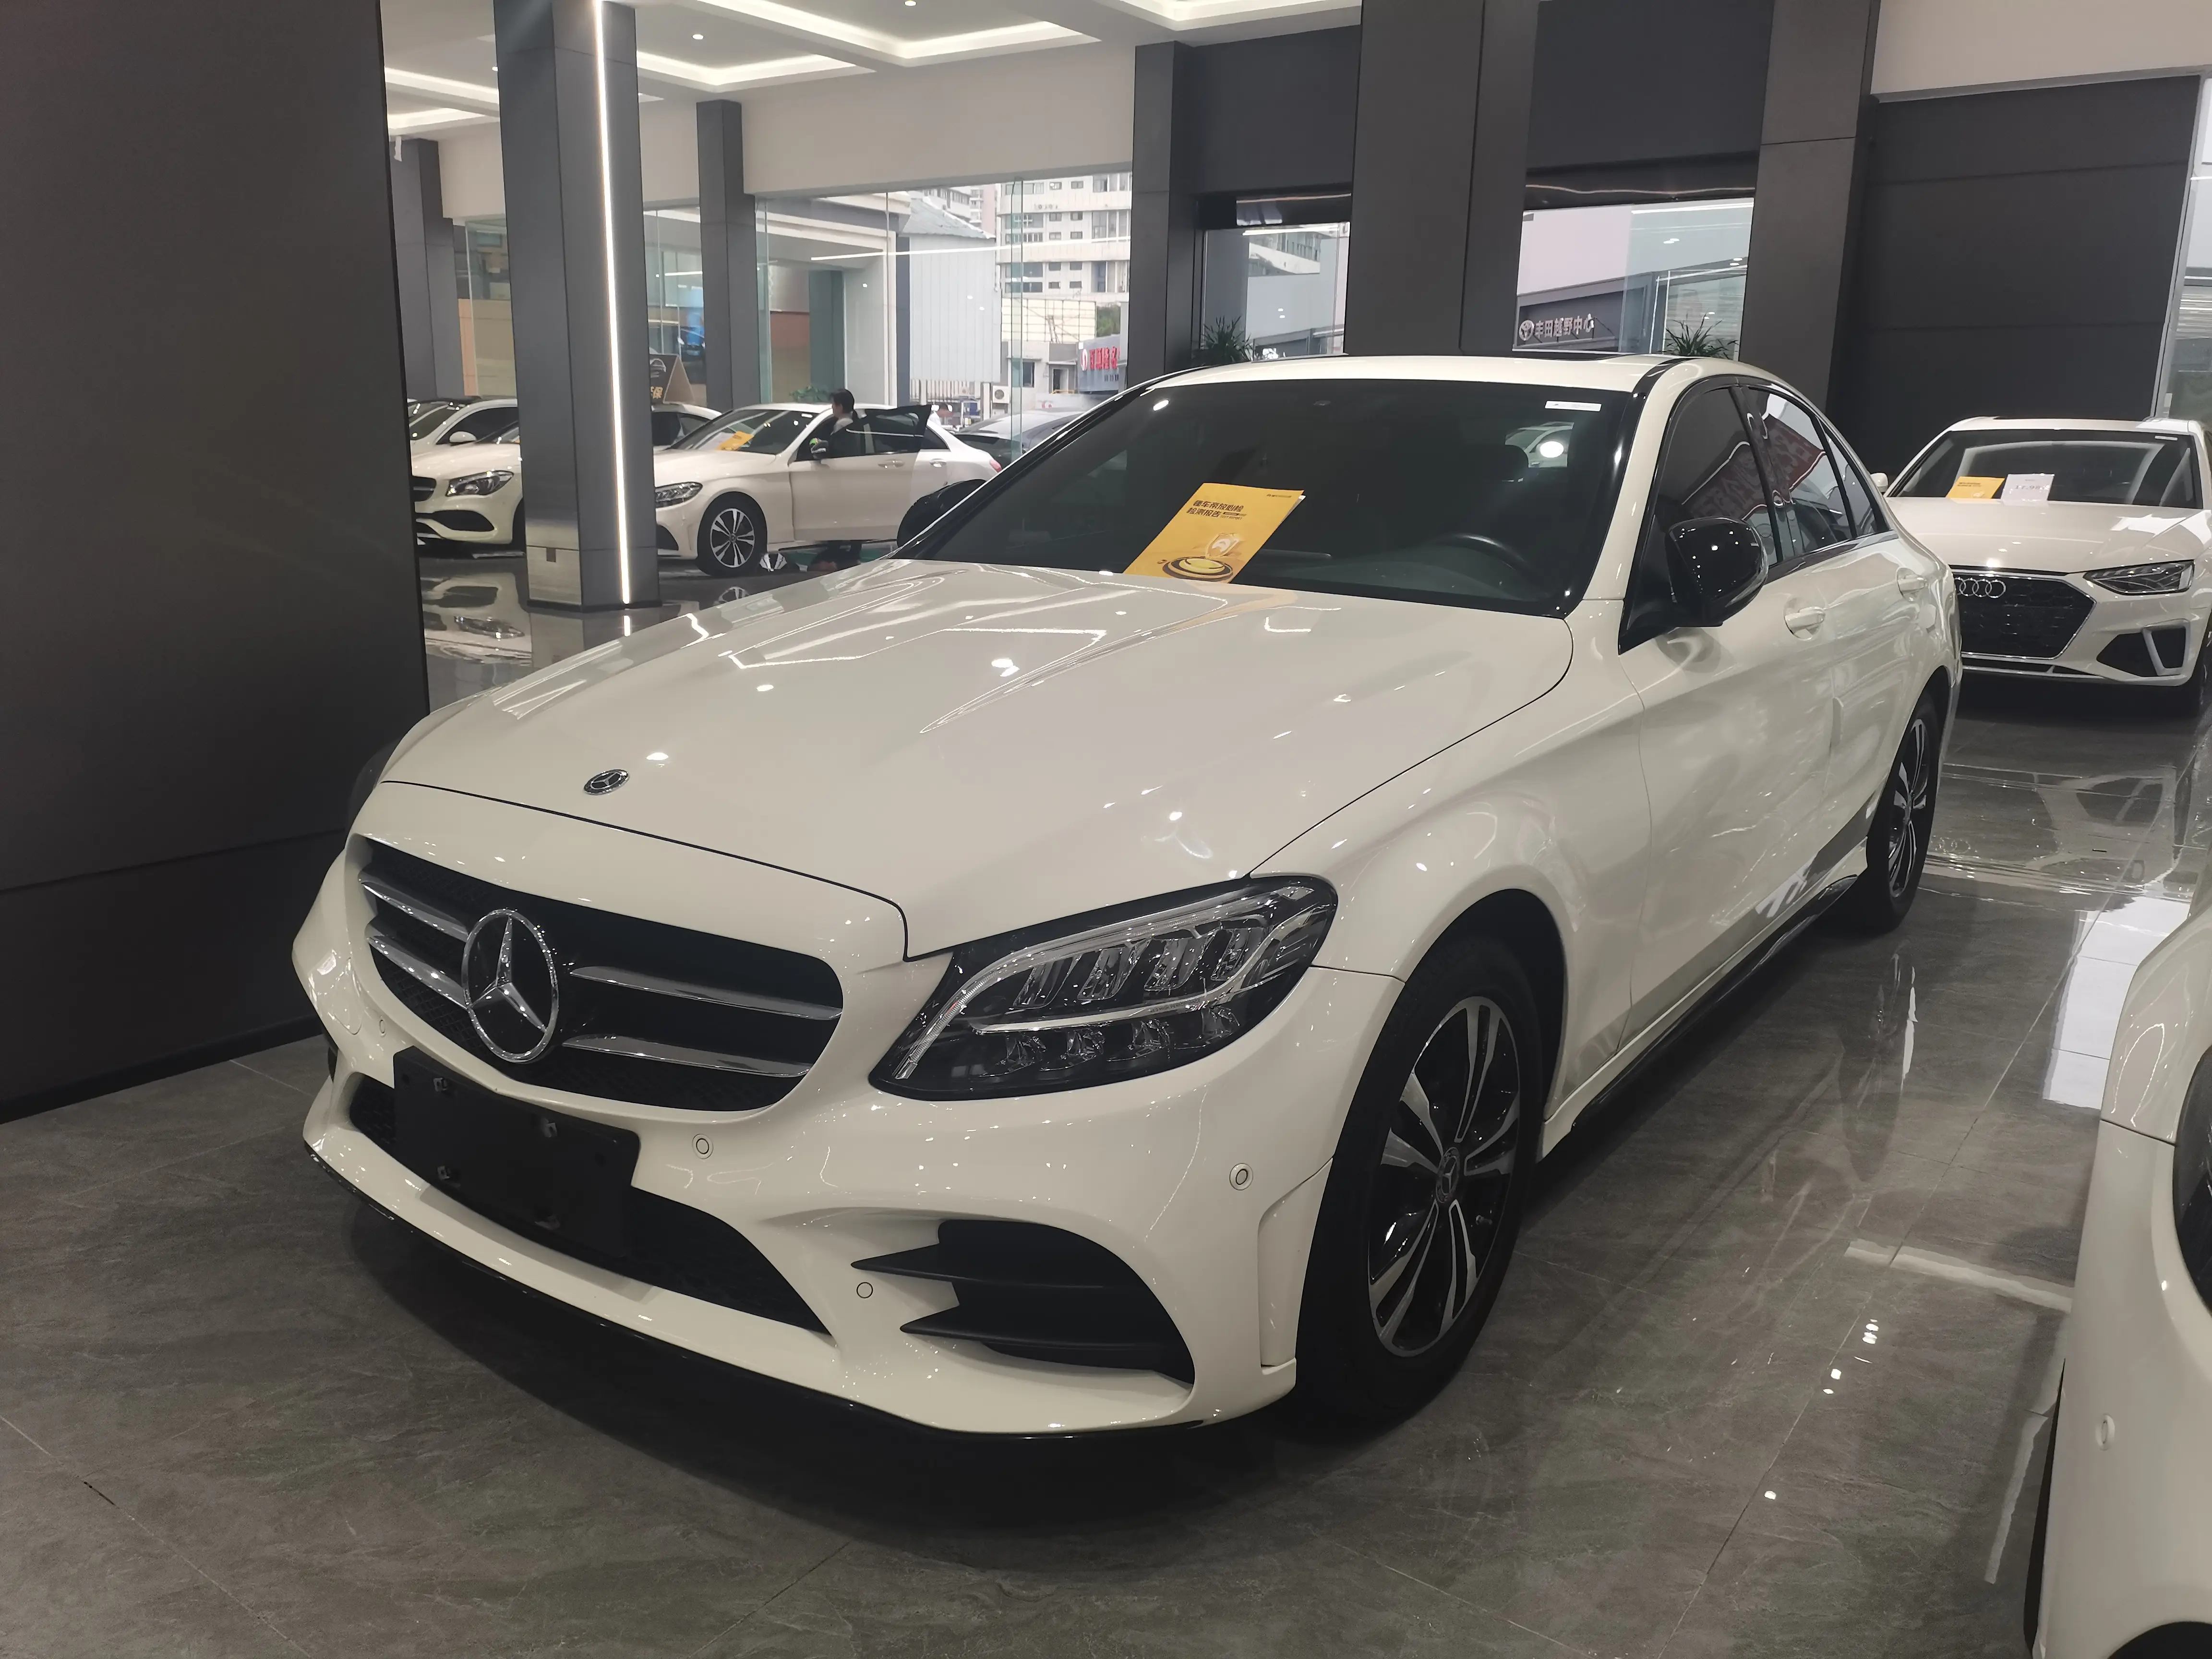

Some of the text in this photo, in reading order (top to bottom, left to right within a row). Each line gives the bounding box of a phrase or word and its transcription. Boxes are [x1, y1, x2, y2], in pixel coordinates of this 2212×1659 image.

[1535, 313, 1594, 338] 丰田越野中心
[1186, 507, 1221, 517] 检测报告
